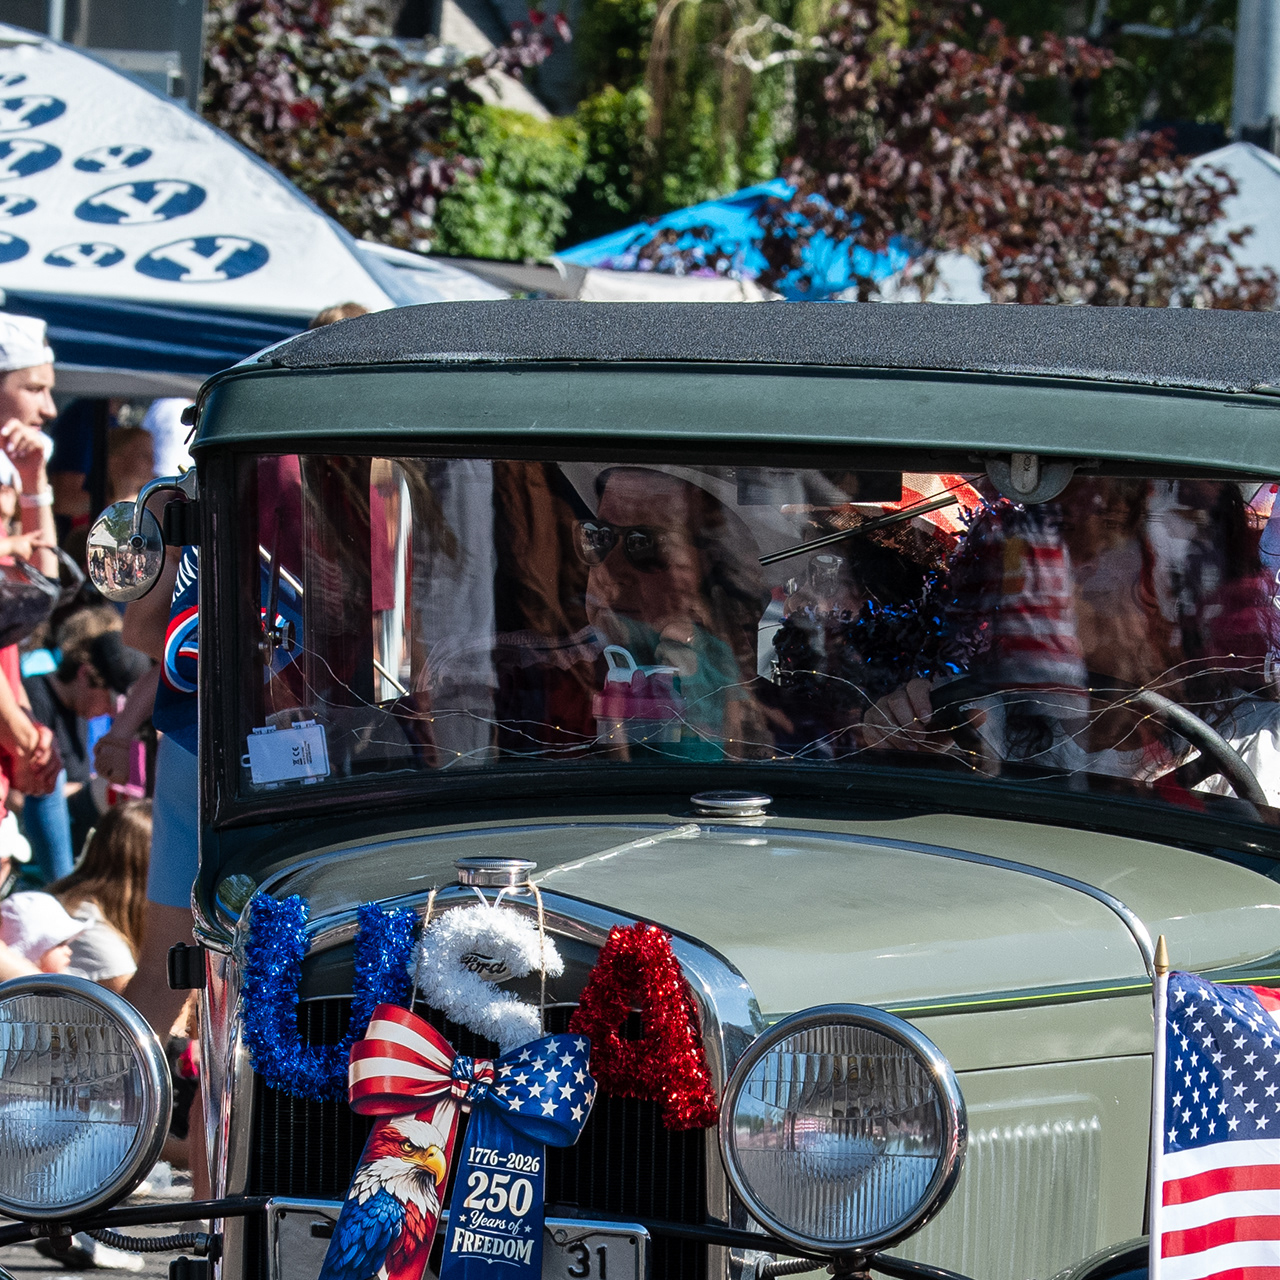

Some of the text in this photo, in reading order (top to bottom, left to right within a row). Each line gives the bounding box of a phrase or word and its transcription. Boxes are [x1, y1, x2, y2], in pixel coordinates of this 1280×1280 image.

[460, 952, 508, 975] Ford
[241, 891, 718, 1130] USA
[463, 1170, 533, 1217] 250
[469, 1210, 523, 1236] Years of
[450, 1227, 535, 1266] FREEDOM
[568, 1241, 608, 1280] 31
